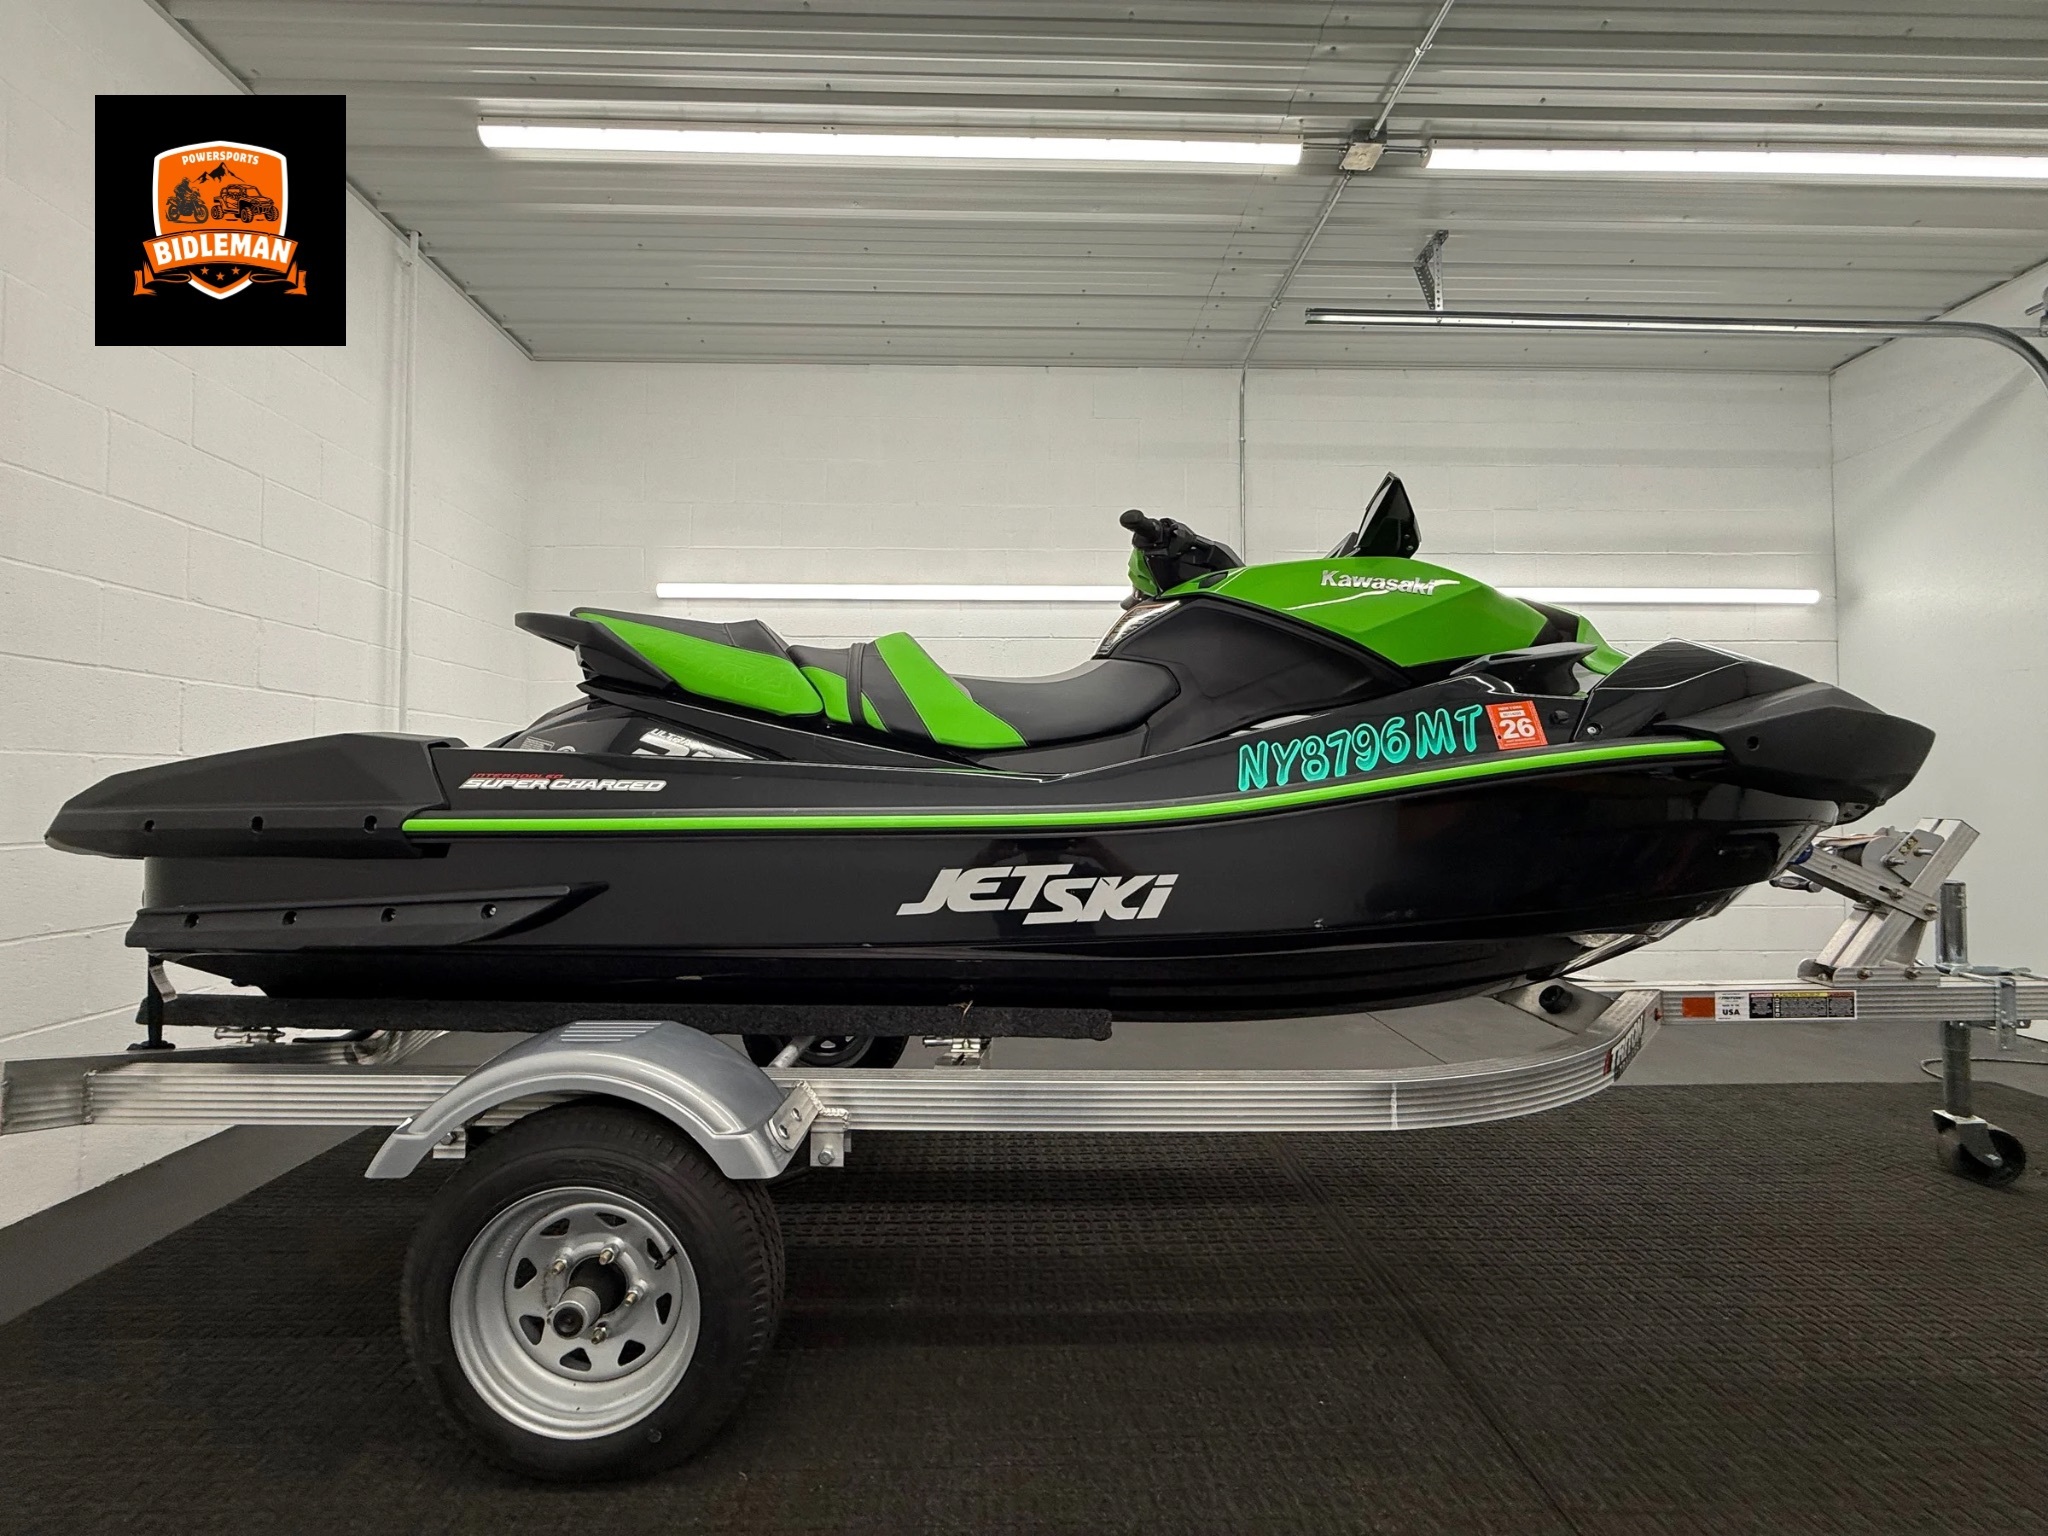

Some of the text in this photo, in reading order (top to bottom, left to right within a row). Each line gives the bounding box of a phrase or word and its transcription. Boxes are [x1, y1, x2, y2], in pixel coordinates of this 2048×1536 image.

[1320, 570, 1436, 596] Kawasaki
[1499, 717, 1536, 740] 26
[1237, 704, 1483, 792] NY8796 MT
